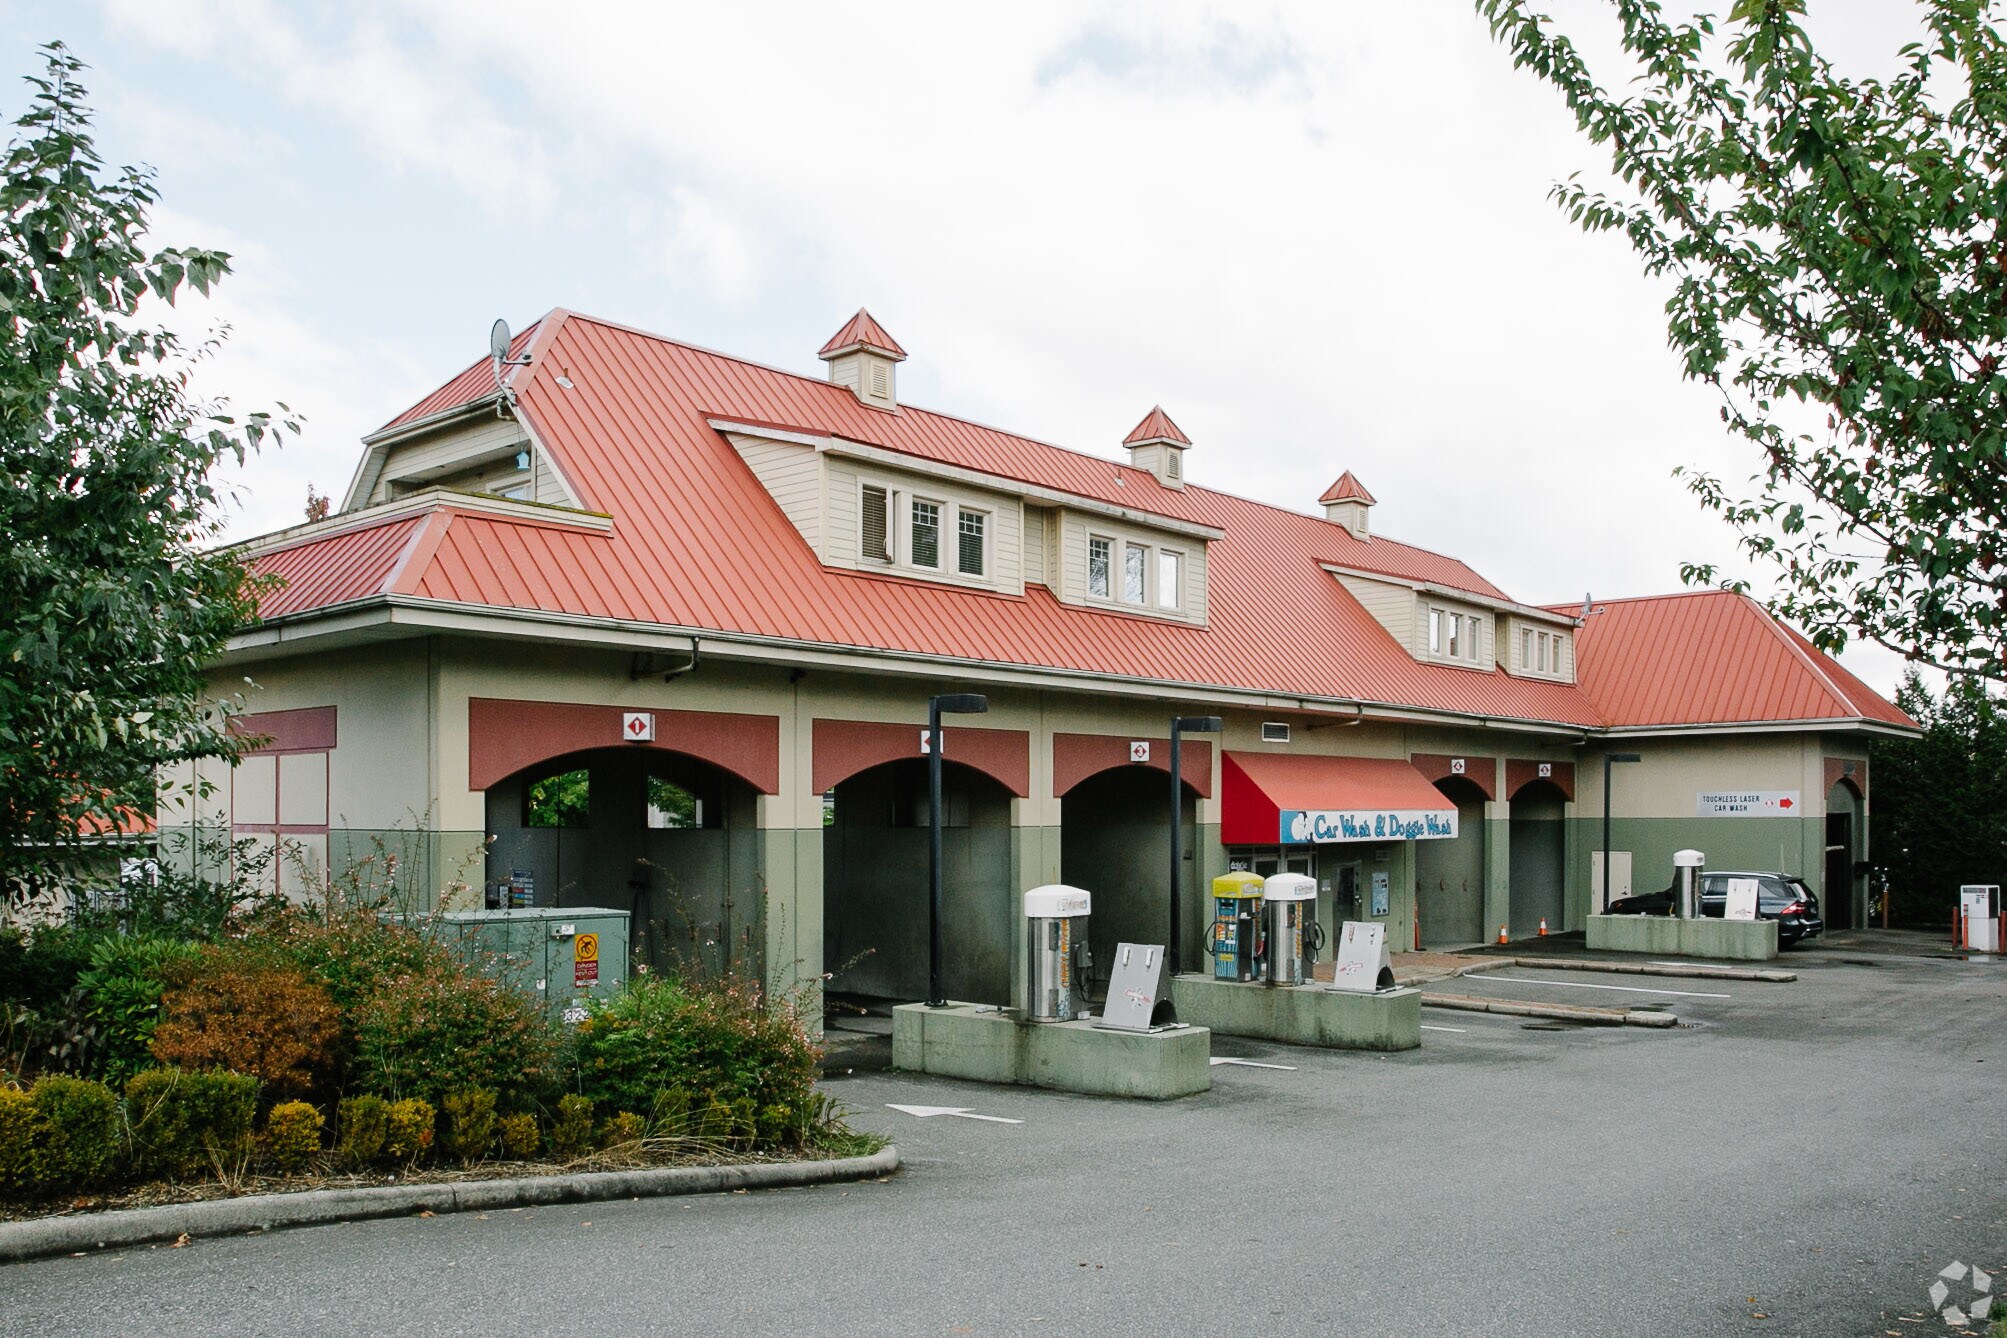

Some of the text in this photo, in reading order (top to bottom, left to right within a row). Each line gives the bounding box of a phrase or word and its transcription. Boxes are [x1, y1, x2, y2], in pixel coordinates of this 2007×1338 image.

[634, 719, 640, 733] 1
[1702, 795, 1760, 803] TOUCHLESS LASER
[1314, 814, 1451, 839] Car Wash & Doggie Wash
